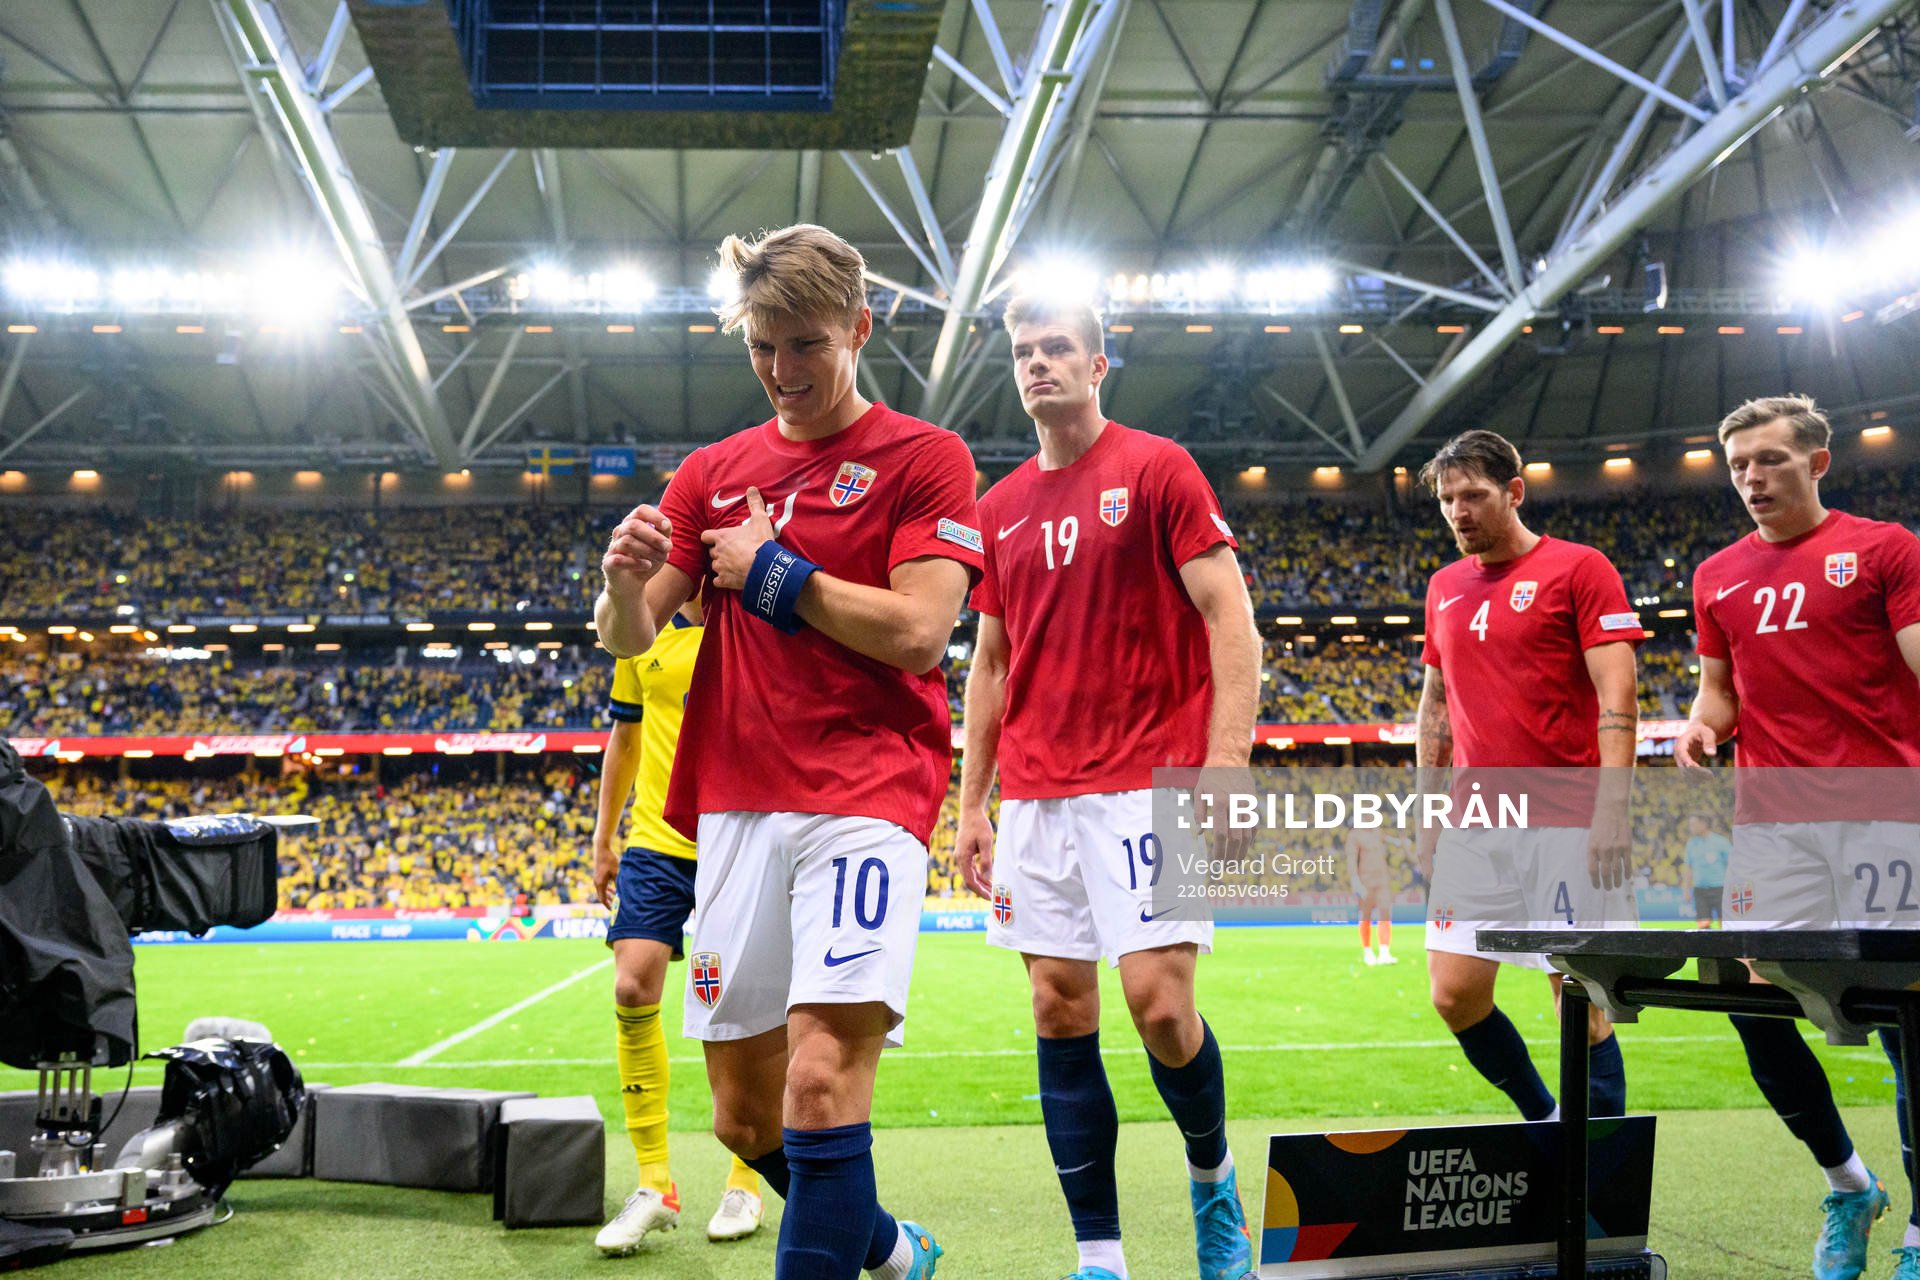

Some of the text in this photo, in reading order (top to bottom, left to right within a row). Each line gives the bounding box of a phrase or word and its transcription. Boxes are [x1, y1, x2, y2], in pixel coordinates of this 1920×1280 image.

[595, 456, 628, 468] FIFA
[1041, 516, 1079, 570] 19
[760, 564, 785, 615] RESPECT
[1753, 581, 1809, 634] 22
[1469, 600, 1491, 641] 4
[1122, 832, 1164, 890] 19
[832, 857, 890, 930] 10
[1554, 881, 1575, 925] 4
[1854, 859, 1919, 914] 22
[553, 918, 609, 938] UEFA
[1408, 1147, 1478, 1176] UEFA
[1405, 1171, 1529, 1203] NATIONS
